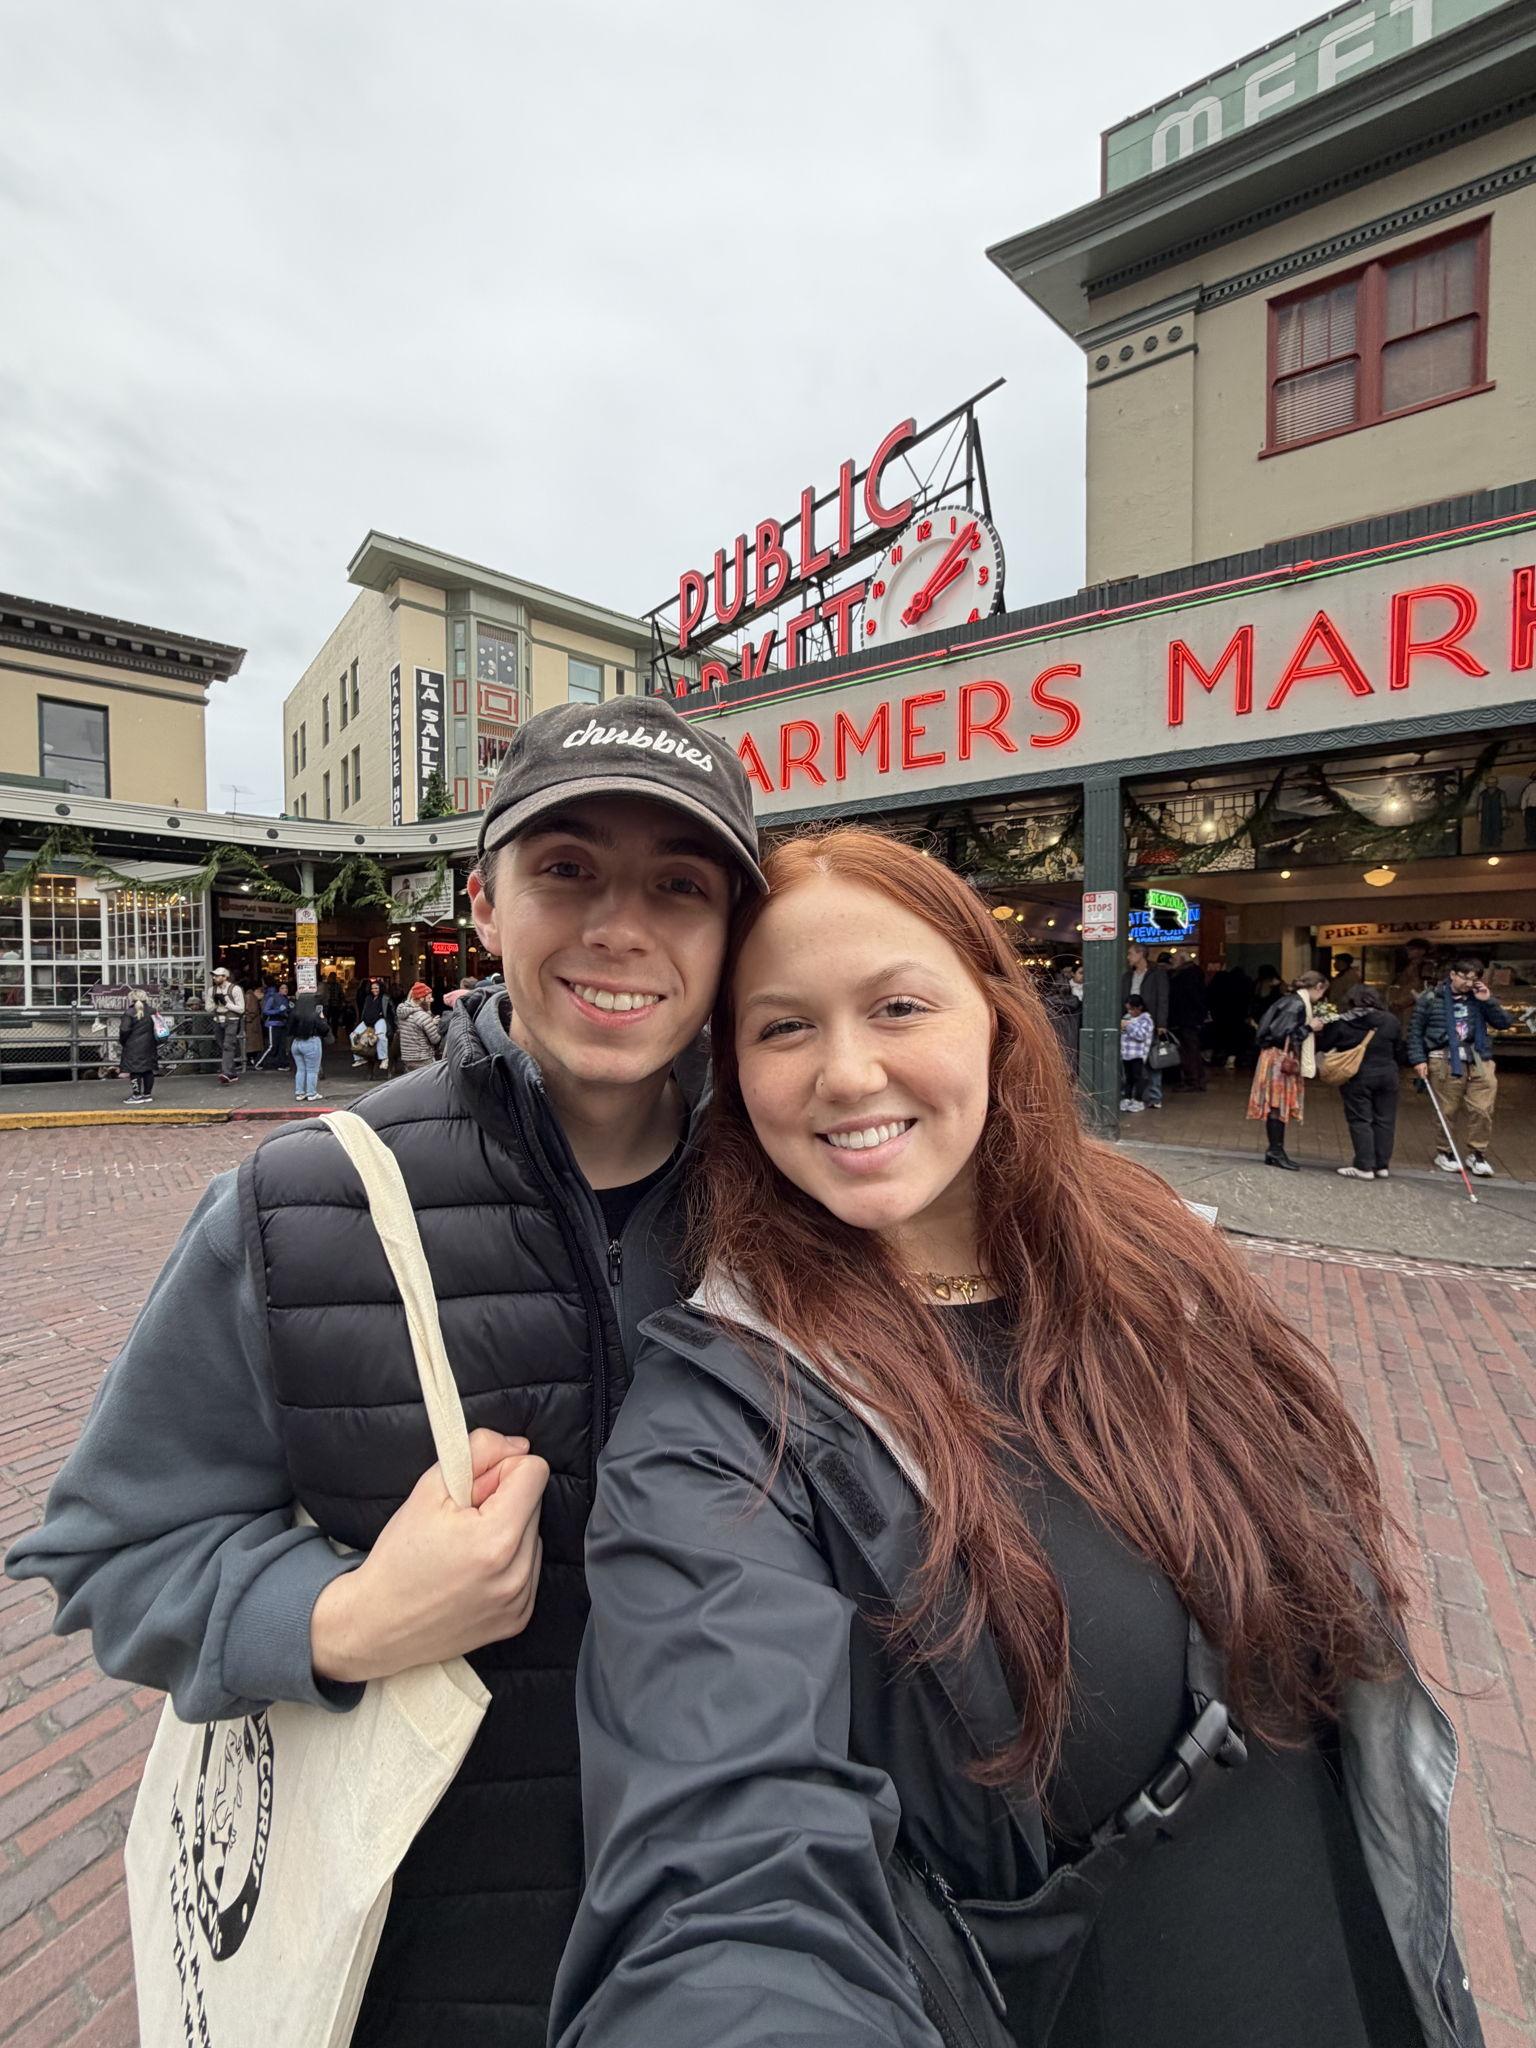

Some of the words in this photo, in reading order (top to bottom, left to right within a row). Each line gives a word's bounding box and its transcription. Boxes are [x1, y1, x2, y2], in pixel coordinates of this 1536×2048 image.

[680, 417, 917, 651] PUBLIC
[917, 520, 932, 542] 12
[970, 531, 981, 551] 2
[891, 544, 903, 566] 11
[977, 566, 989, 586] 3
[872, 580, 886, 600] 10
[966, 607, 979, 624] 4
[866, 619, 877, 636] 9
[391, 673, 399, 701] LA
[420, 671, 440, 703] LA
[734, 664, 1082, 794] ARMERS
[392, 704, 400, 778] SALLE
[562, 719, 713, 772] chubbies
[1087, 904, 1112, 912] STOPS
[1324, 925, 1369, 940] PIKE
[1376, 920, 1441, 934] PLACE
[1450, 919, 1536, 933] BAKERY
